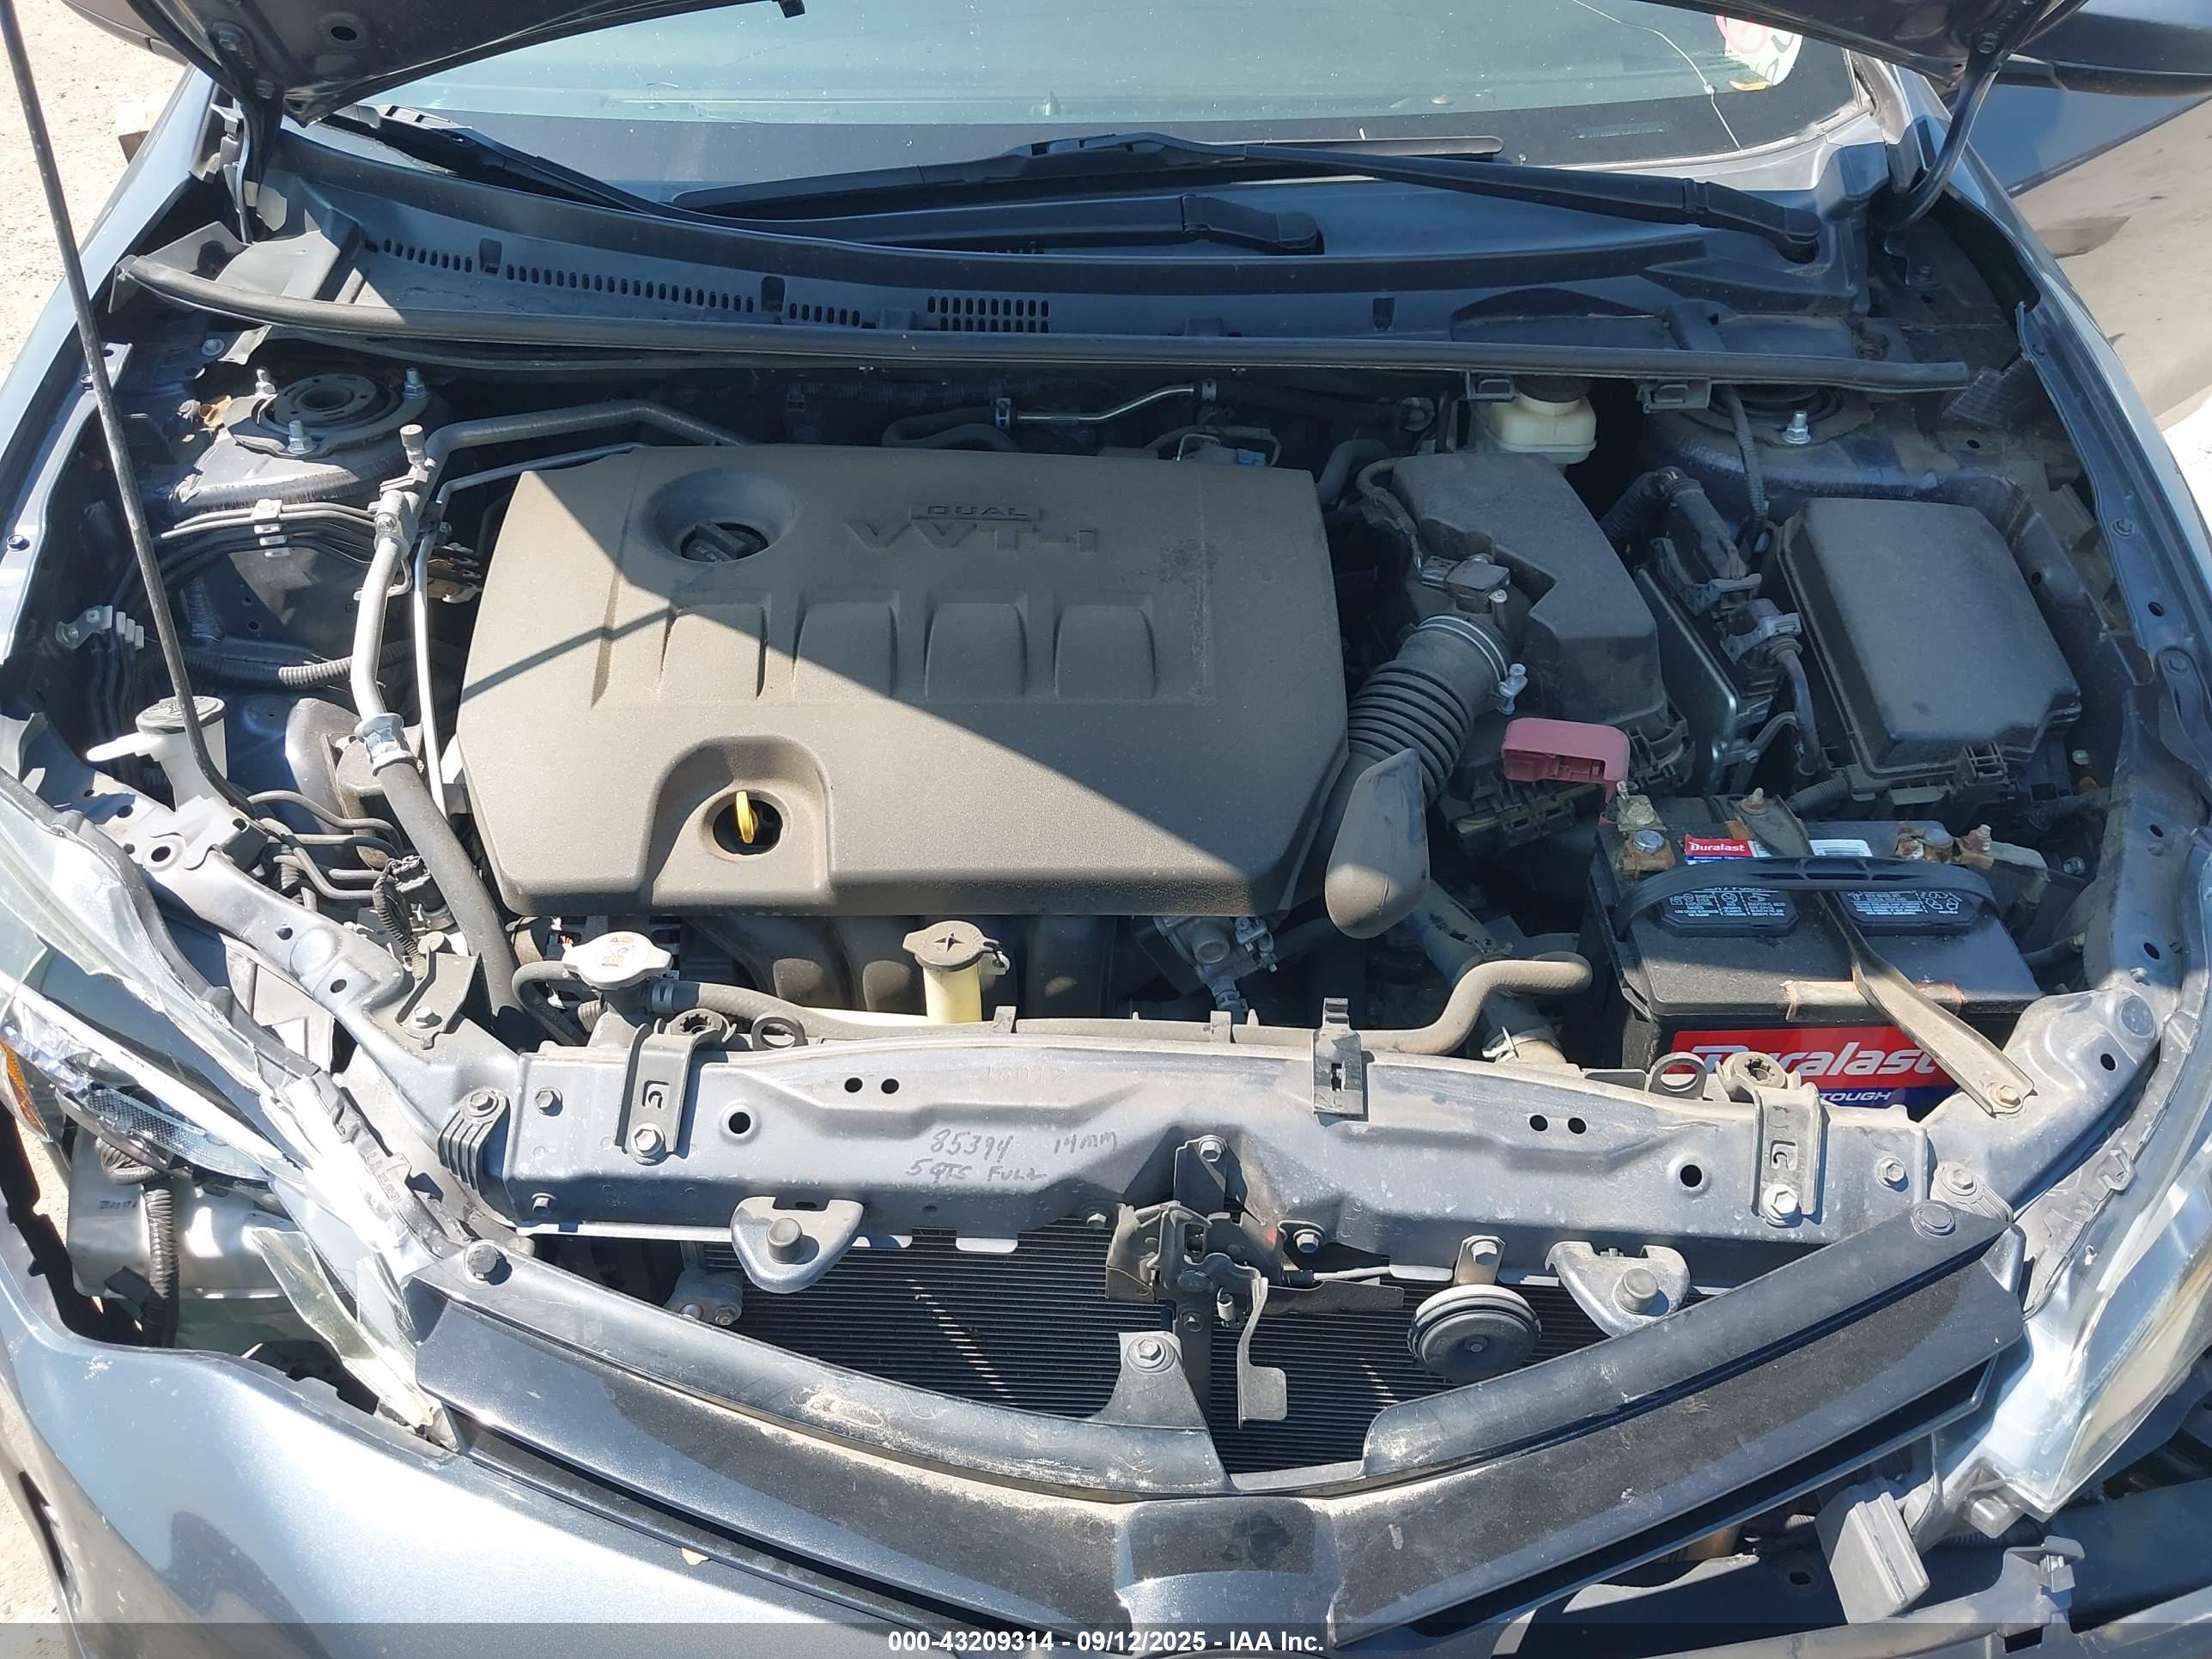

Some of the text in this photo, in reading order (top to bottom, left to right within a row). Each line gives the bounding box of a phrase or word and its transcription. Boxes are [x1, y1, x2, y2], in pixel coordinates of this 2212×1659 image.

[927, 506, 1028, 515] DUAL
[1688, 841, 1746, 852] Duralast
[1820, 1091, 1893, 1102] TOUGH
